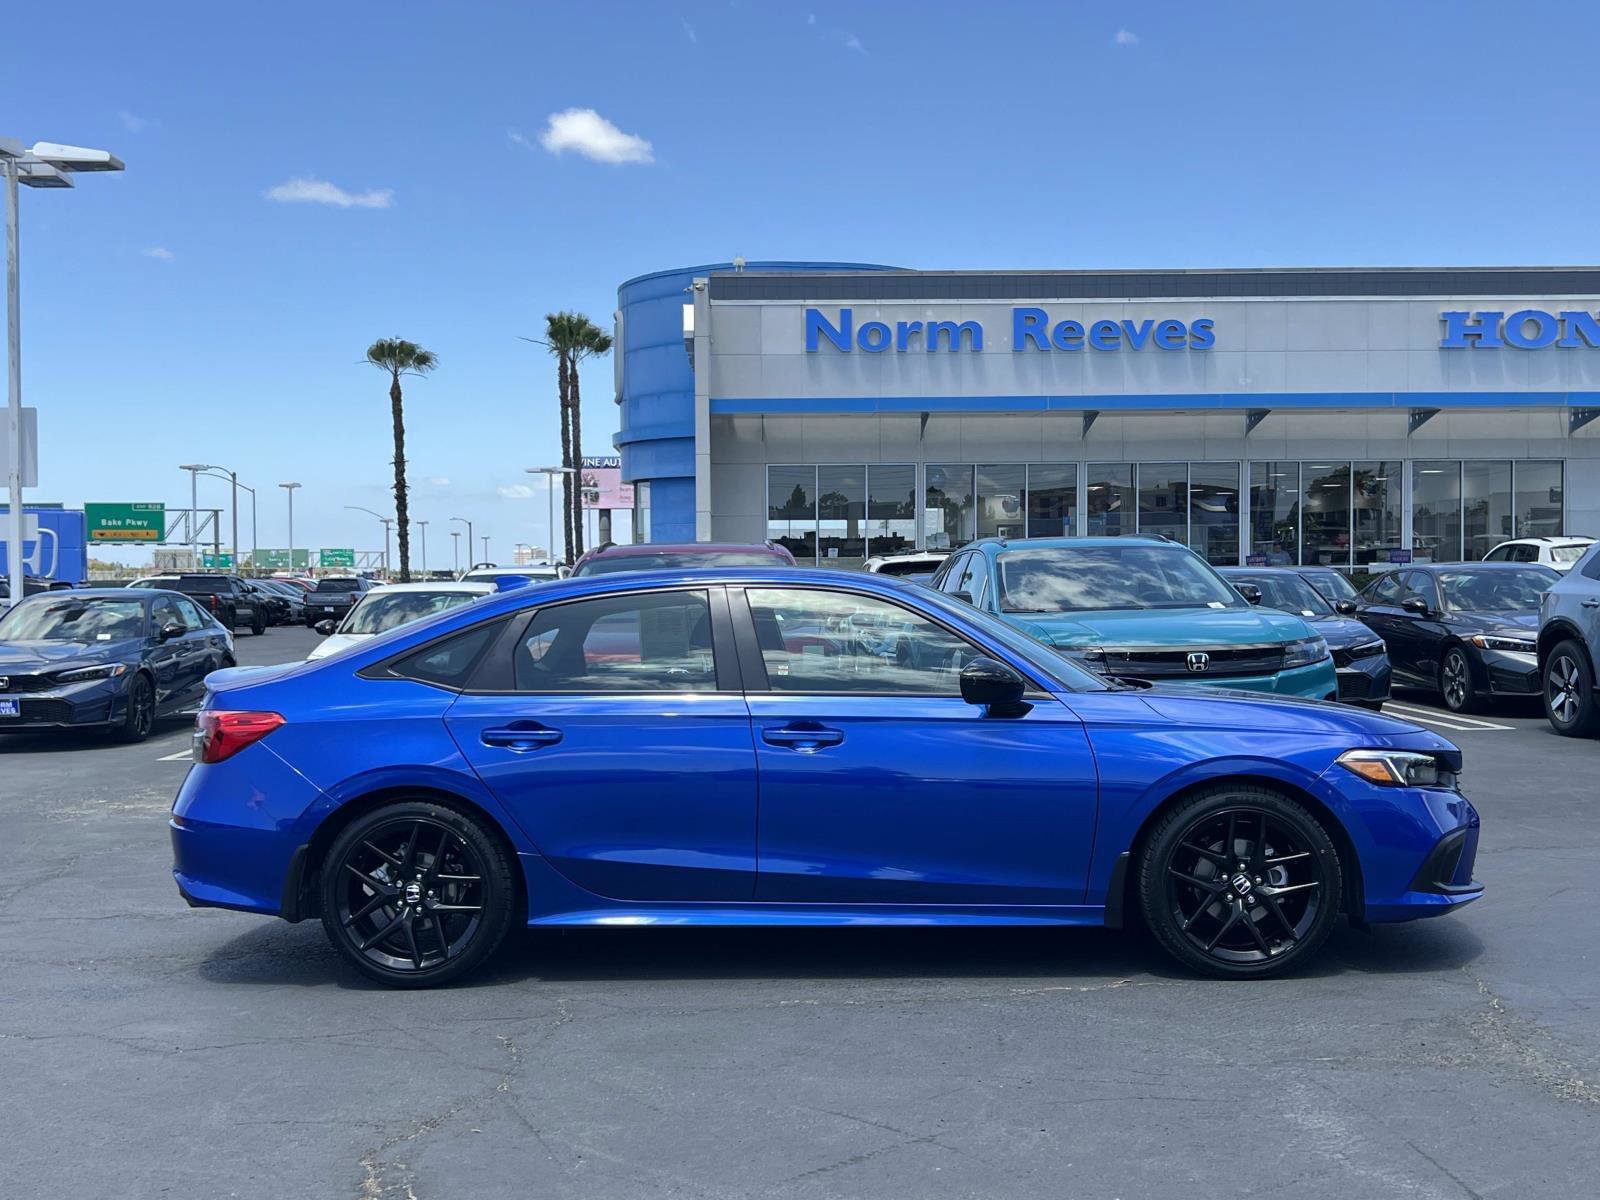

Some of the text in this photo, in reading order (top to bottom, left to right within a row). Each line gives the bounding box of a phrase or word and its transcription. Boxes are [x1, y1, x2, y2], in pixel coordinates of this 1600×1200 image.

[805, 307, 1216, 353] Norm Reeves
[101, 518, 149, 527] Bake Pkwy
